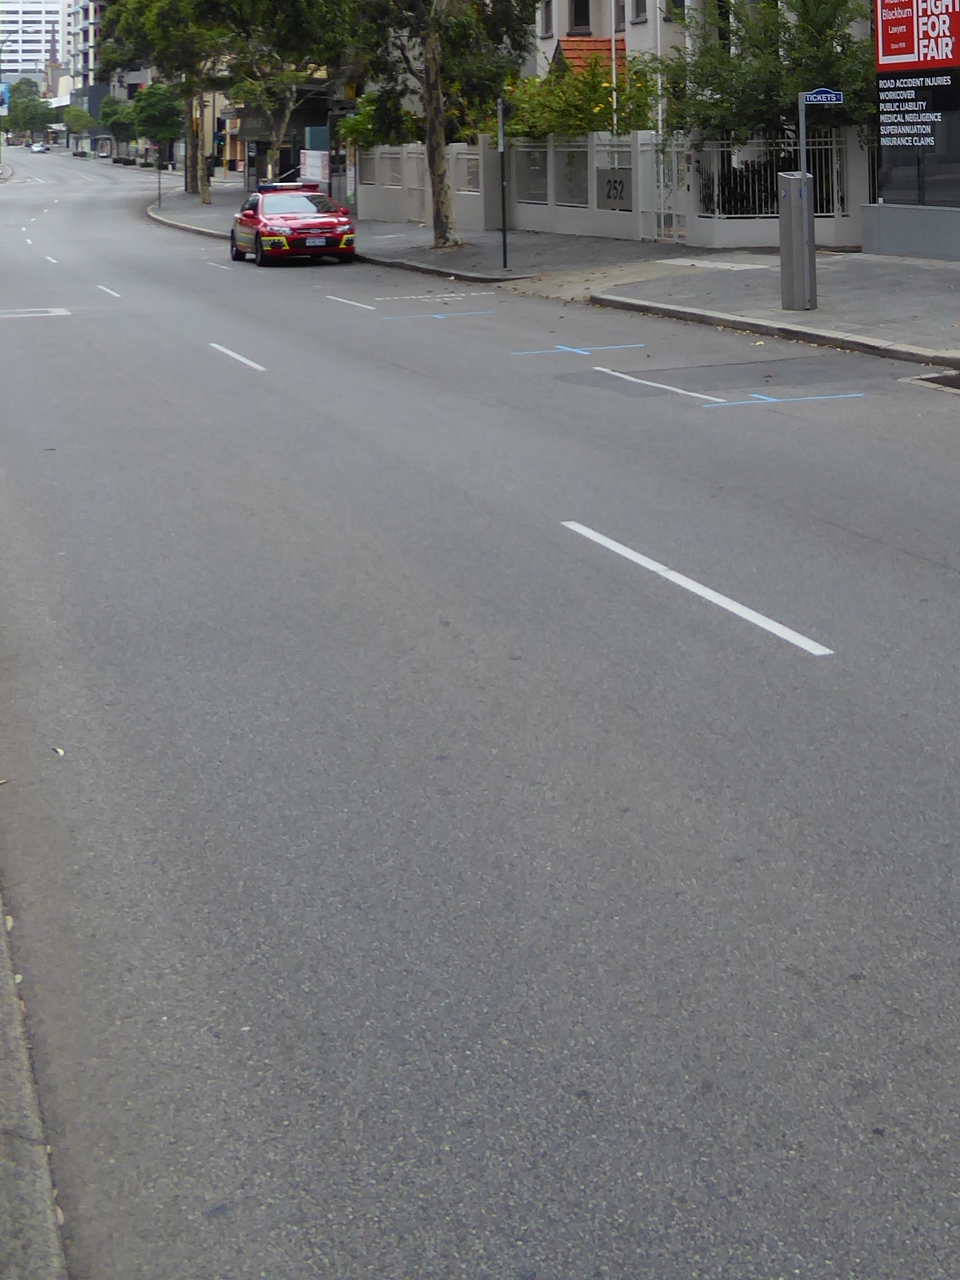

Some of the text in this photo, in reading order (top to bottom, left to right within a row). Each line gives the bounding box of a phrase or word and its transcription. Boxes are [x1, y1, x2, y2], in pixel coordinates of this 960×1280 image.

[882, 7, 912, 20] Blackburn
[888, 25, 907, 34] Lawyers
[919, 14, 950, 39] FOR
[879, 76, 952, 88] ROAD ACCIDENT INJURIES
[805, 94, 837, 102] TICKETS
[879, 90, 915, 100] WORKCOVER
[880, 101, 927, 111] PUBLIC LIABILITY
[880, 112, 942, 123] MEDICAL NEGLIGENCE
[880, 125, 931, 134] SUPERANNUATION
[881, 136, 935, 146] INSURANCE CLAIMS
[606, 179, 624, 200] 252
